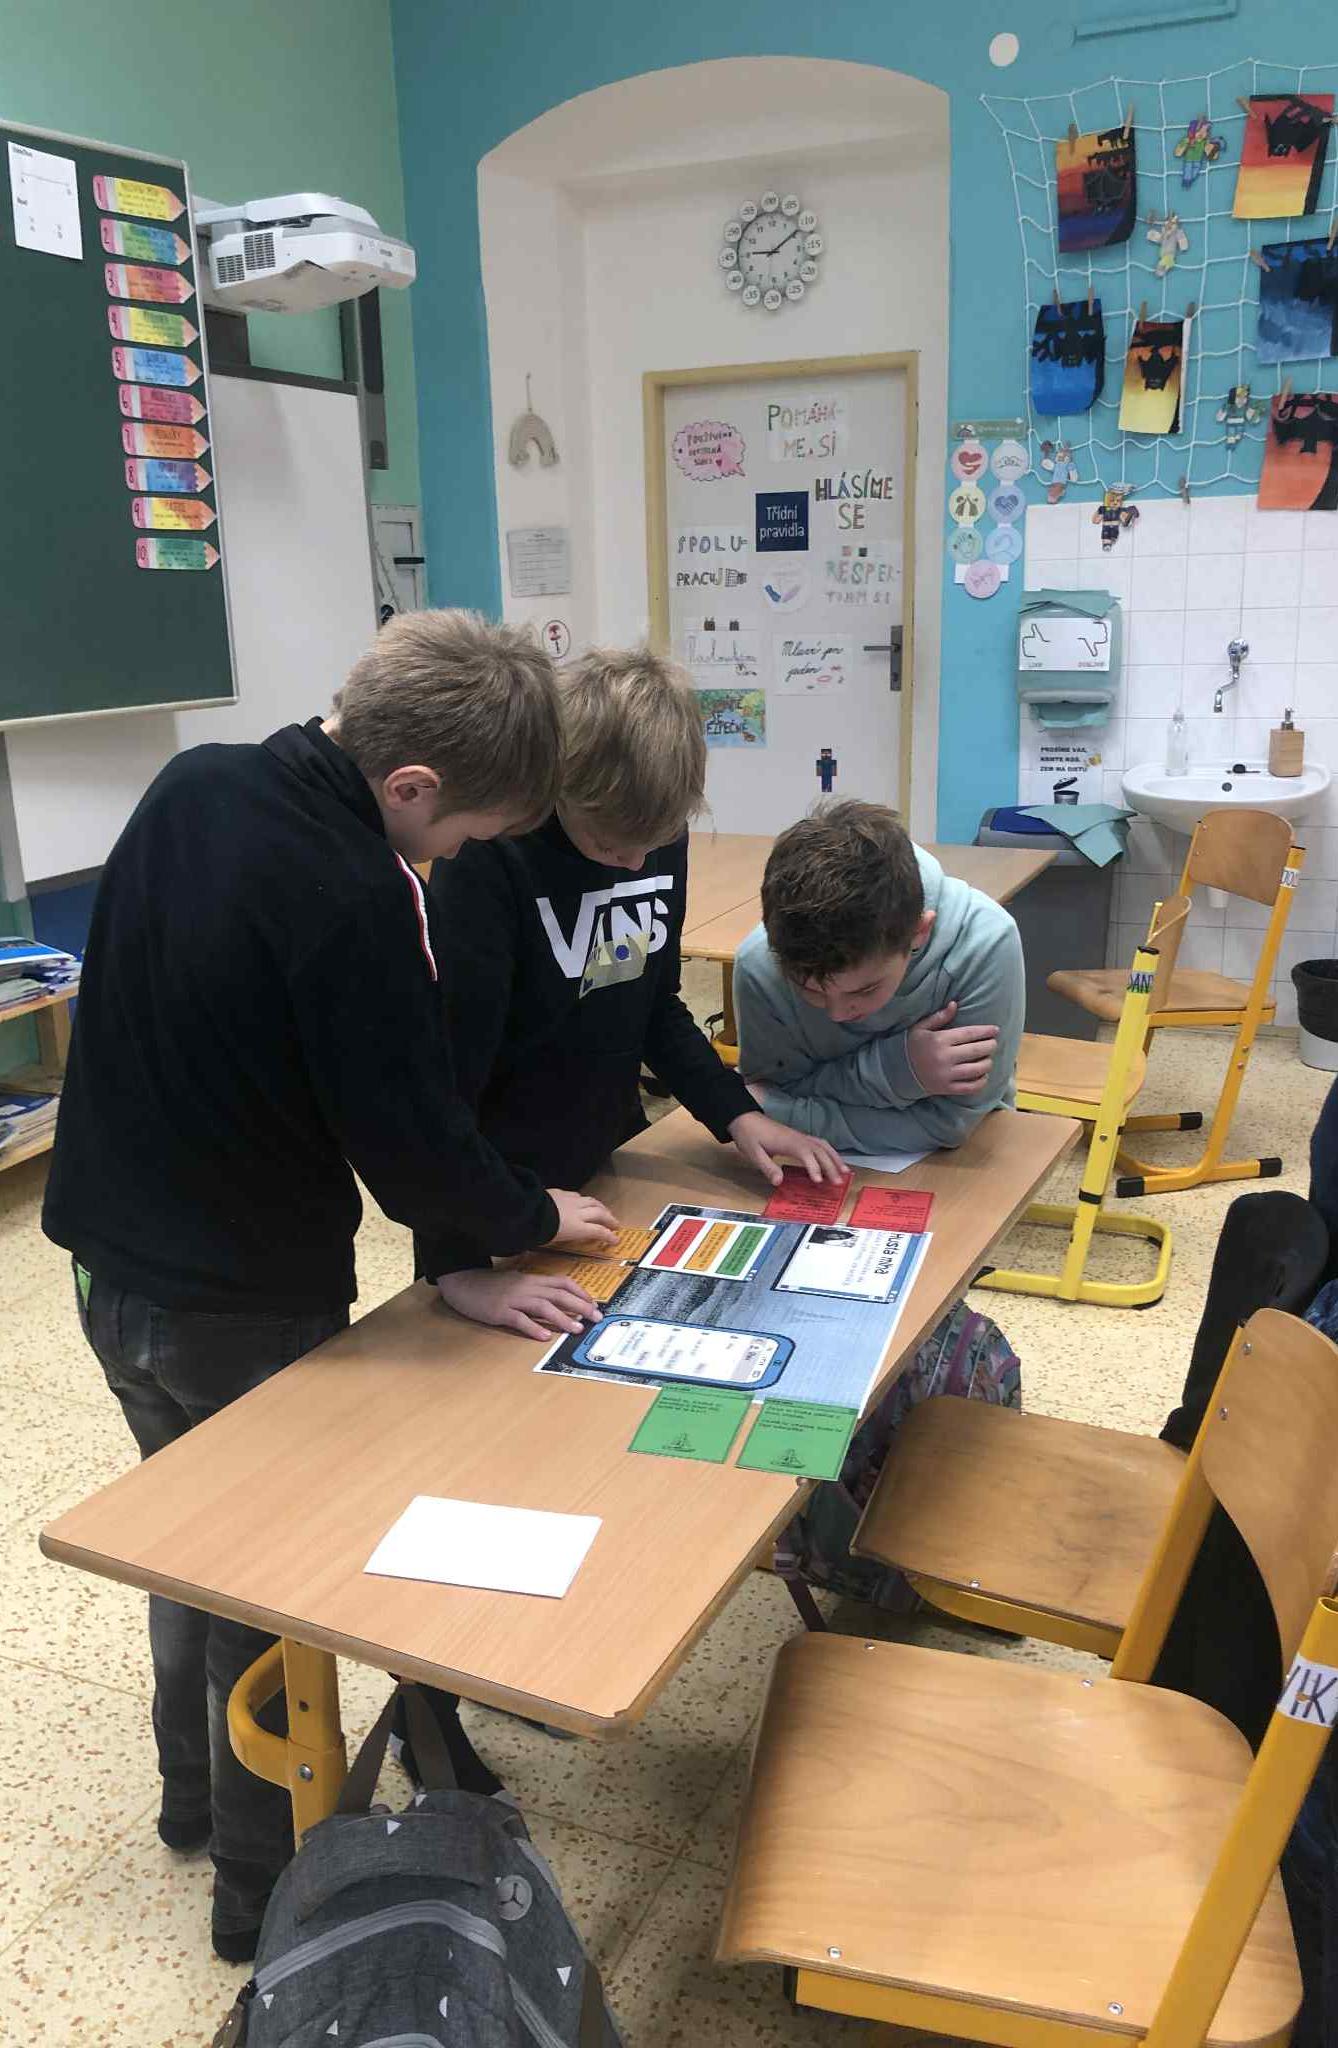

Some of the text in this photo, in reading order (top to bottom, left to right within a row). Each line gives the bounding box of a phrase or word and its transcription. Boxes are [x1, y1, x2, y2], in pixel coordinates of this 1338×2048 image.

[814, 469, 894, 501] HLÁSÍME
[766, 505, 799, 522] Třídní
[838, 502, 865, 530] SE
[759, 523, 805, 541] pravidla
[535, 875, 674, 979] VANS
